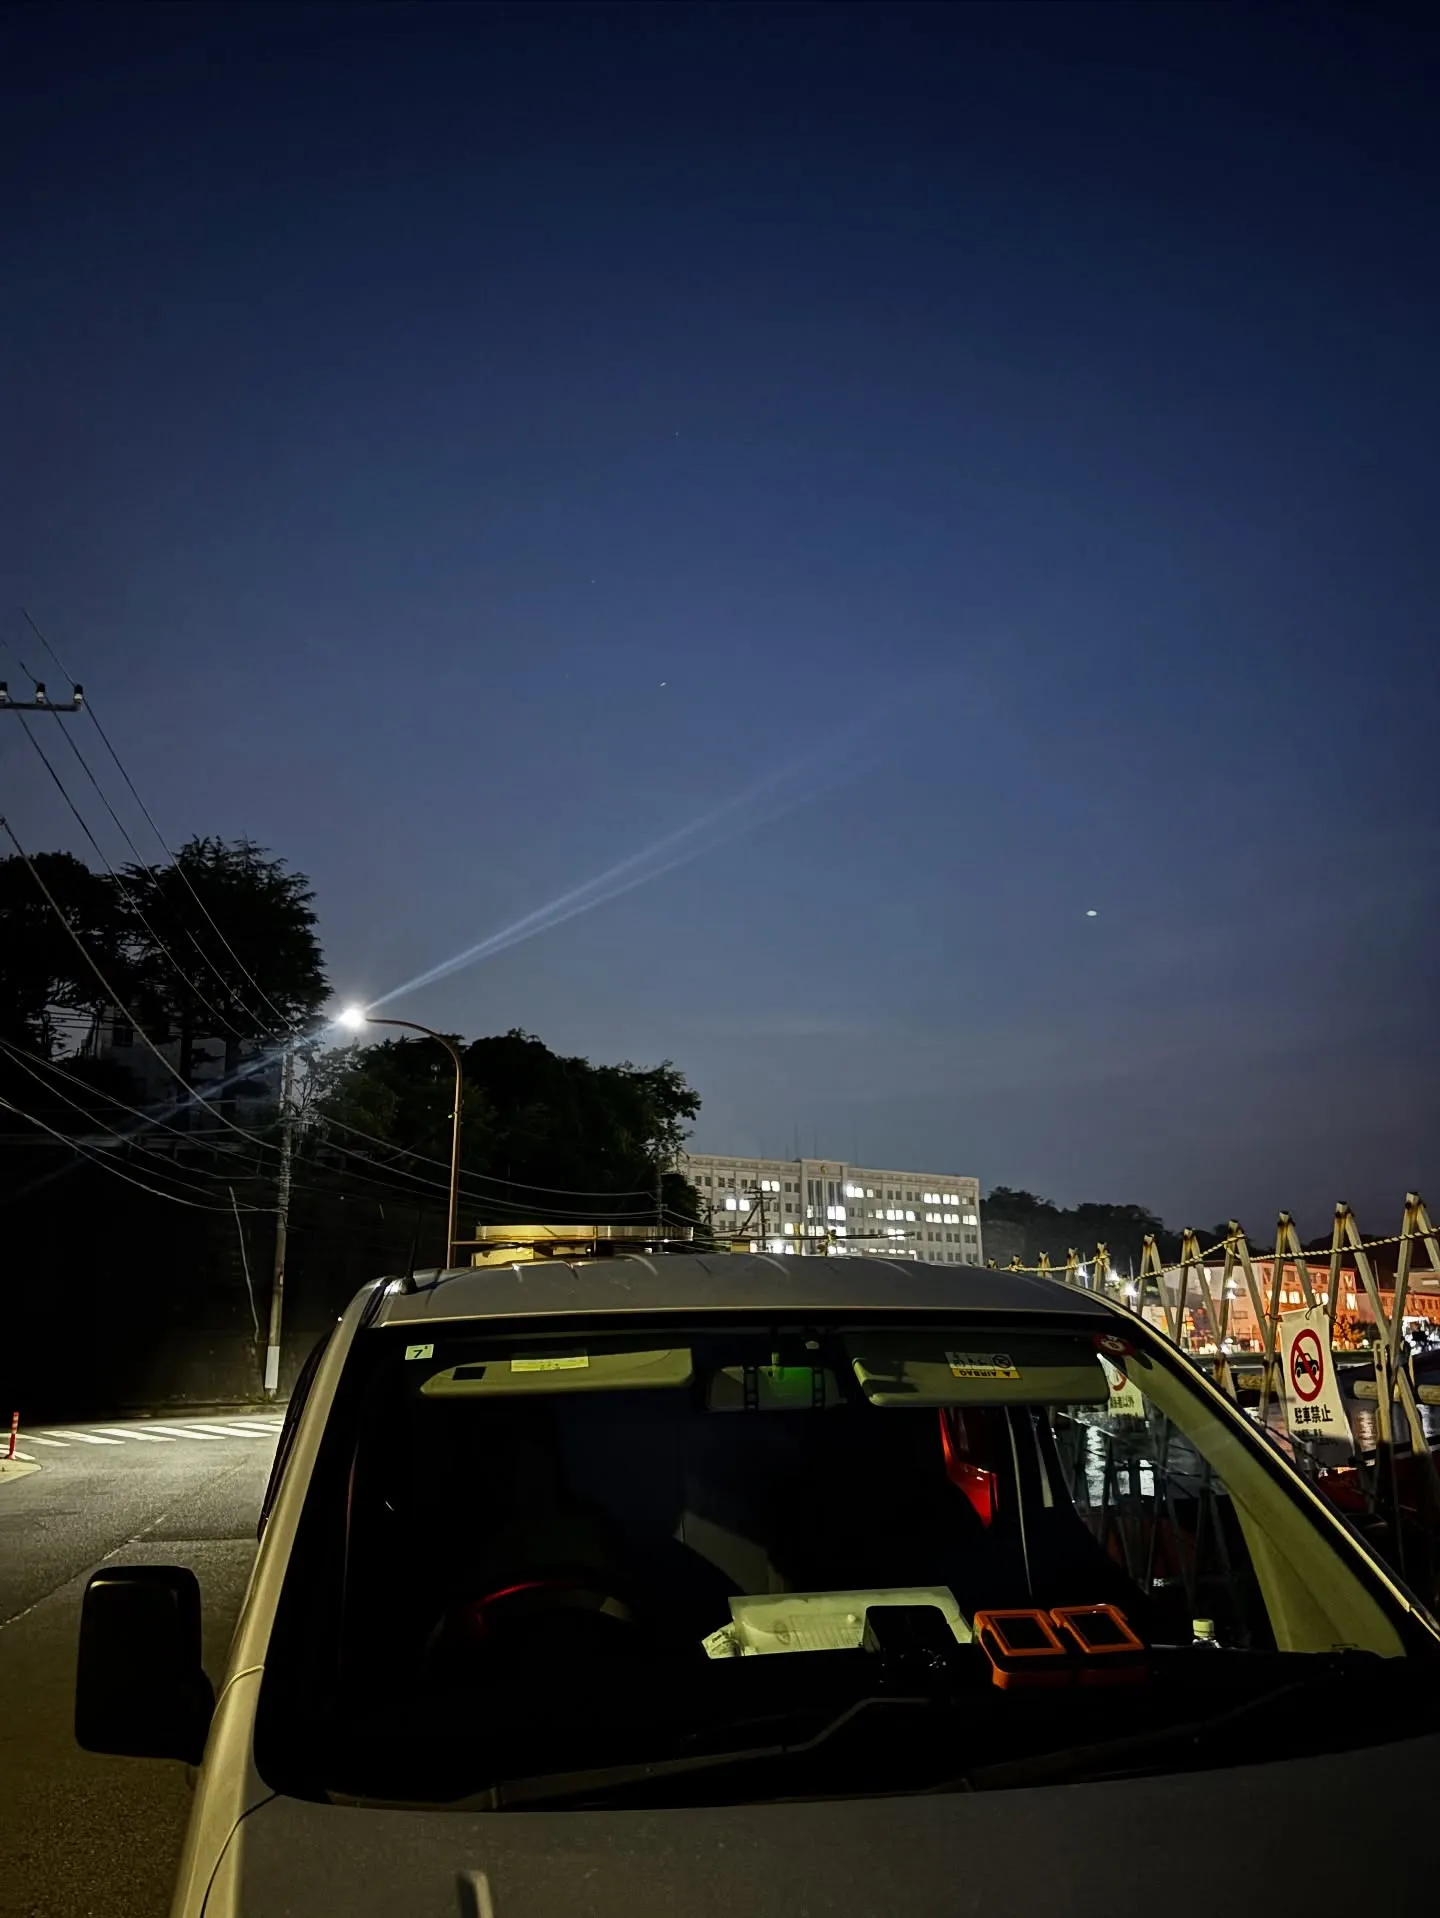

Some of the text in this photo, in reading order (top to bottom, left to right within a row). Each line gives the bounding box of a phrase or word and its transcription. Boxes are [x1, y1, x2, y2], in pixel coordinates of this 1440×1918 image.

[413, 1349, 423, 1359] 7
[1294, 1404, 1333, 1424] 駐車禁止
